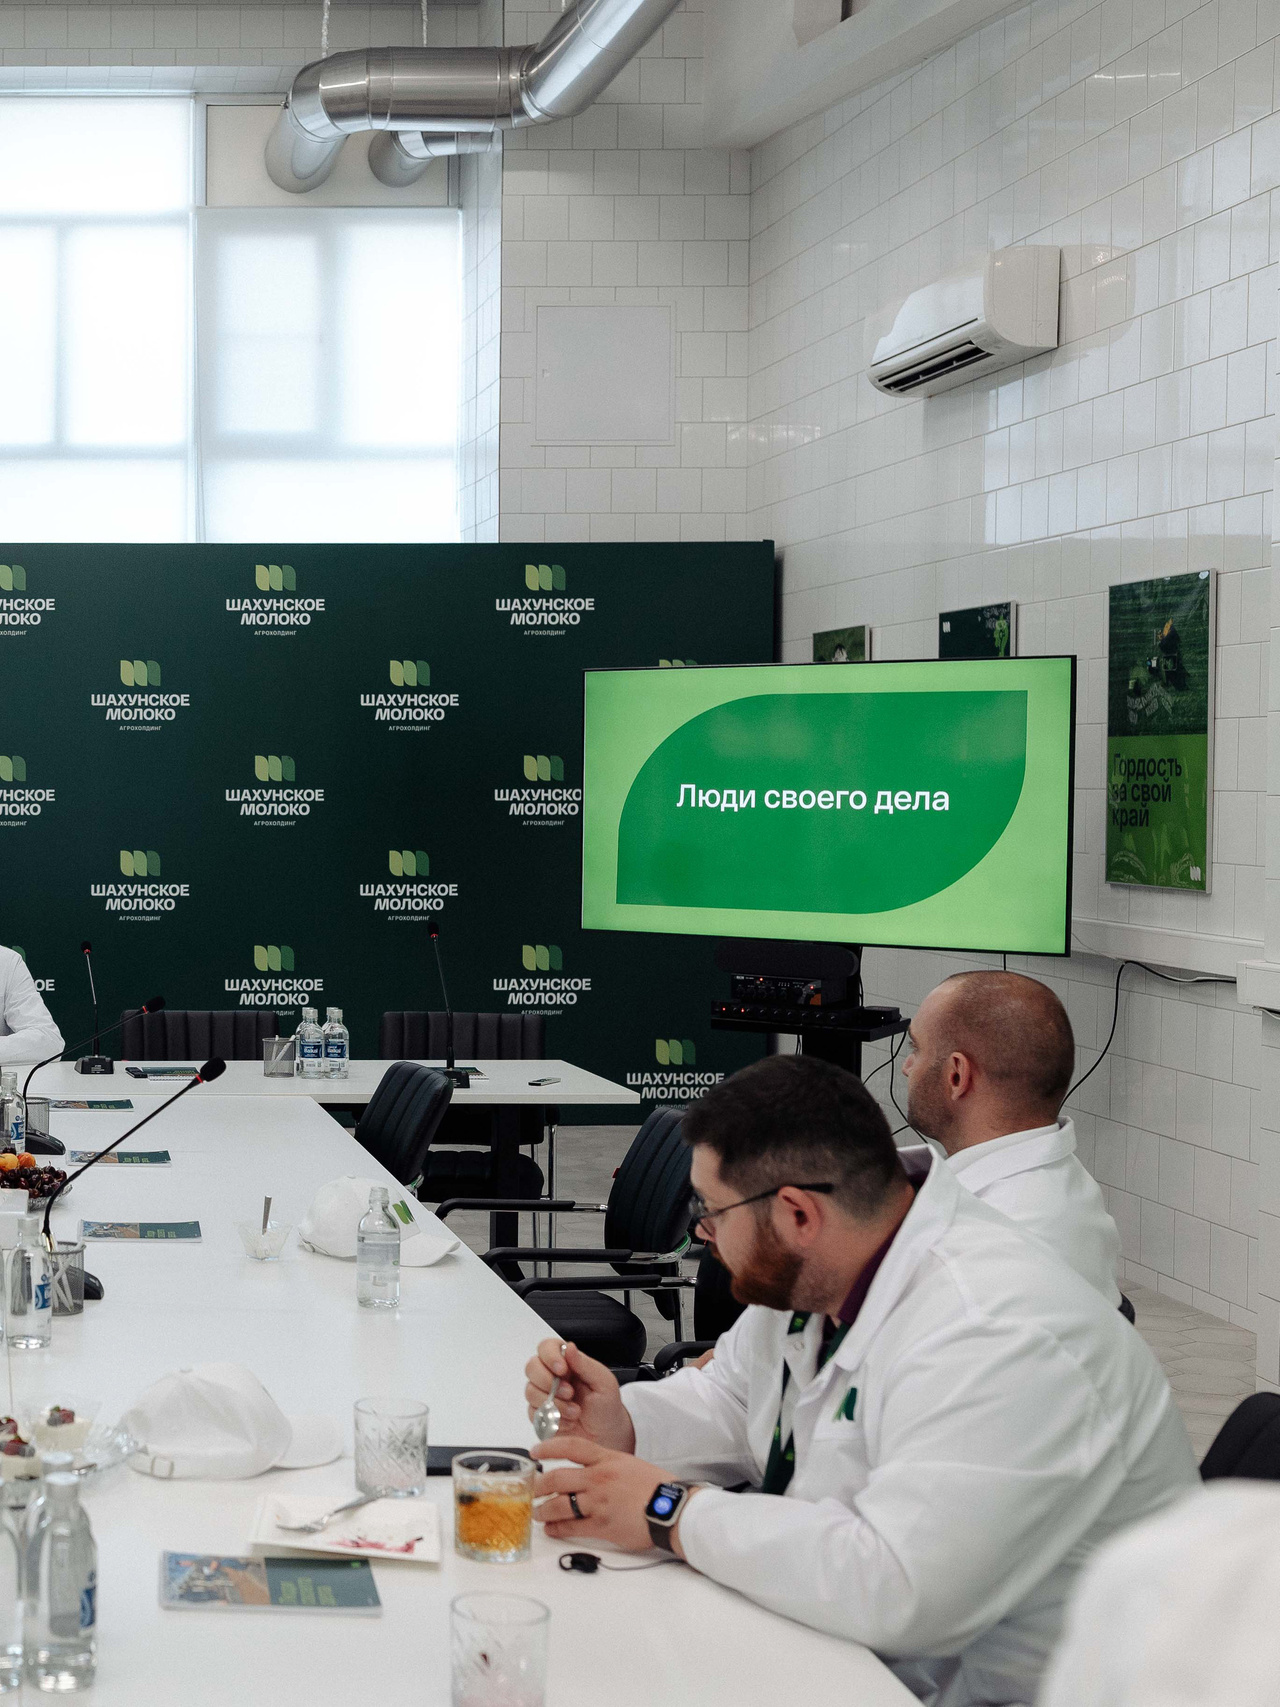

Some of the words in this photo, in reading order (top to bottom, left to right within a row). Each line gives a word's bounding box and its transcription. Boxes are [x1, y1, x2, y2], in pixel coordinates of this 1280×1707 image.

[225, 598, 326, 611] ШАХУНСКОЕ
[495, 597, 595, 611] ШАХУНСКОЕ
[240, 612, 312, 626] МОЛОКО
[509, 612, 581, 626] МОЛОКО
[90, 693, 191, 707] ШАХУНСКОЕ
[360, 693, 460, 707] ШАХУНСКОЕ
[105, 707, 176, 721] МОЛОКО
[374, 707, 445, 721] МОЛОКО
[1113, 753, 1183, 782] Гордость
[225, 788, 325, 802] ШАХУНСКОЕ
[494, 788, 582, 802] ШАХУНСКО
[1111, 783, 1127, 802] за
[1131, 777, 1172, 802] свой
[676, 784, 756, 812] Люди
[764, 789, 867, 810] своего
[874, 790, 950, 815] дела
[239, 803, 311, 816] МОЛОКО
[508, 803, 580, 816] МОЛОКО
[1111, 802, 1150, 832] край
[90, 883, 190, 897] ШАХУНСКОЕ
[359, 883, 459, 897] ШАХУНСКОЕ
[105, 898, 176, 911] МОЛОКО
[374, 897, 444, 911] МОЛОКО
[224, 978, 324, 992] ШАХУНСКОЕ
[493, 978, 592, 991] ШАХУНСКОЕ
[239, 992, 310, 1006] МОЛОКО
[507, 992, 578, 1005] МОЛОКО
[626, 1072, 725, 1085] ШАХУНСКОЕ
